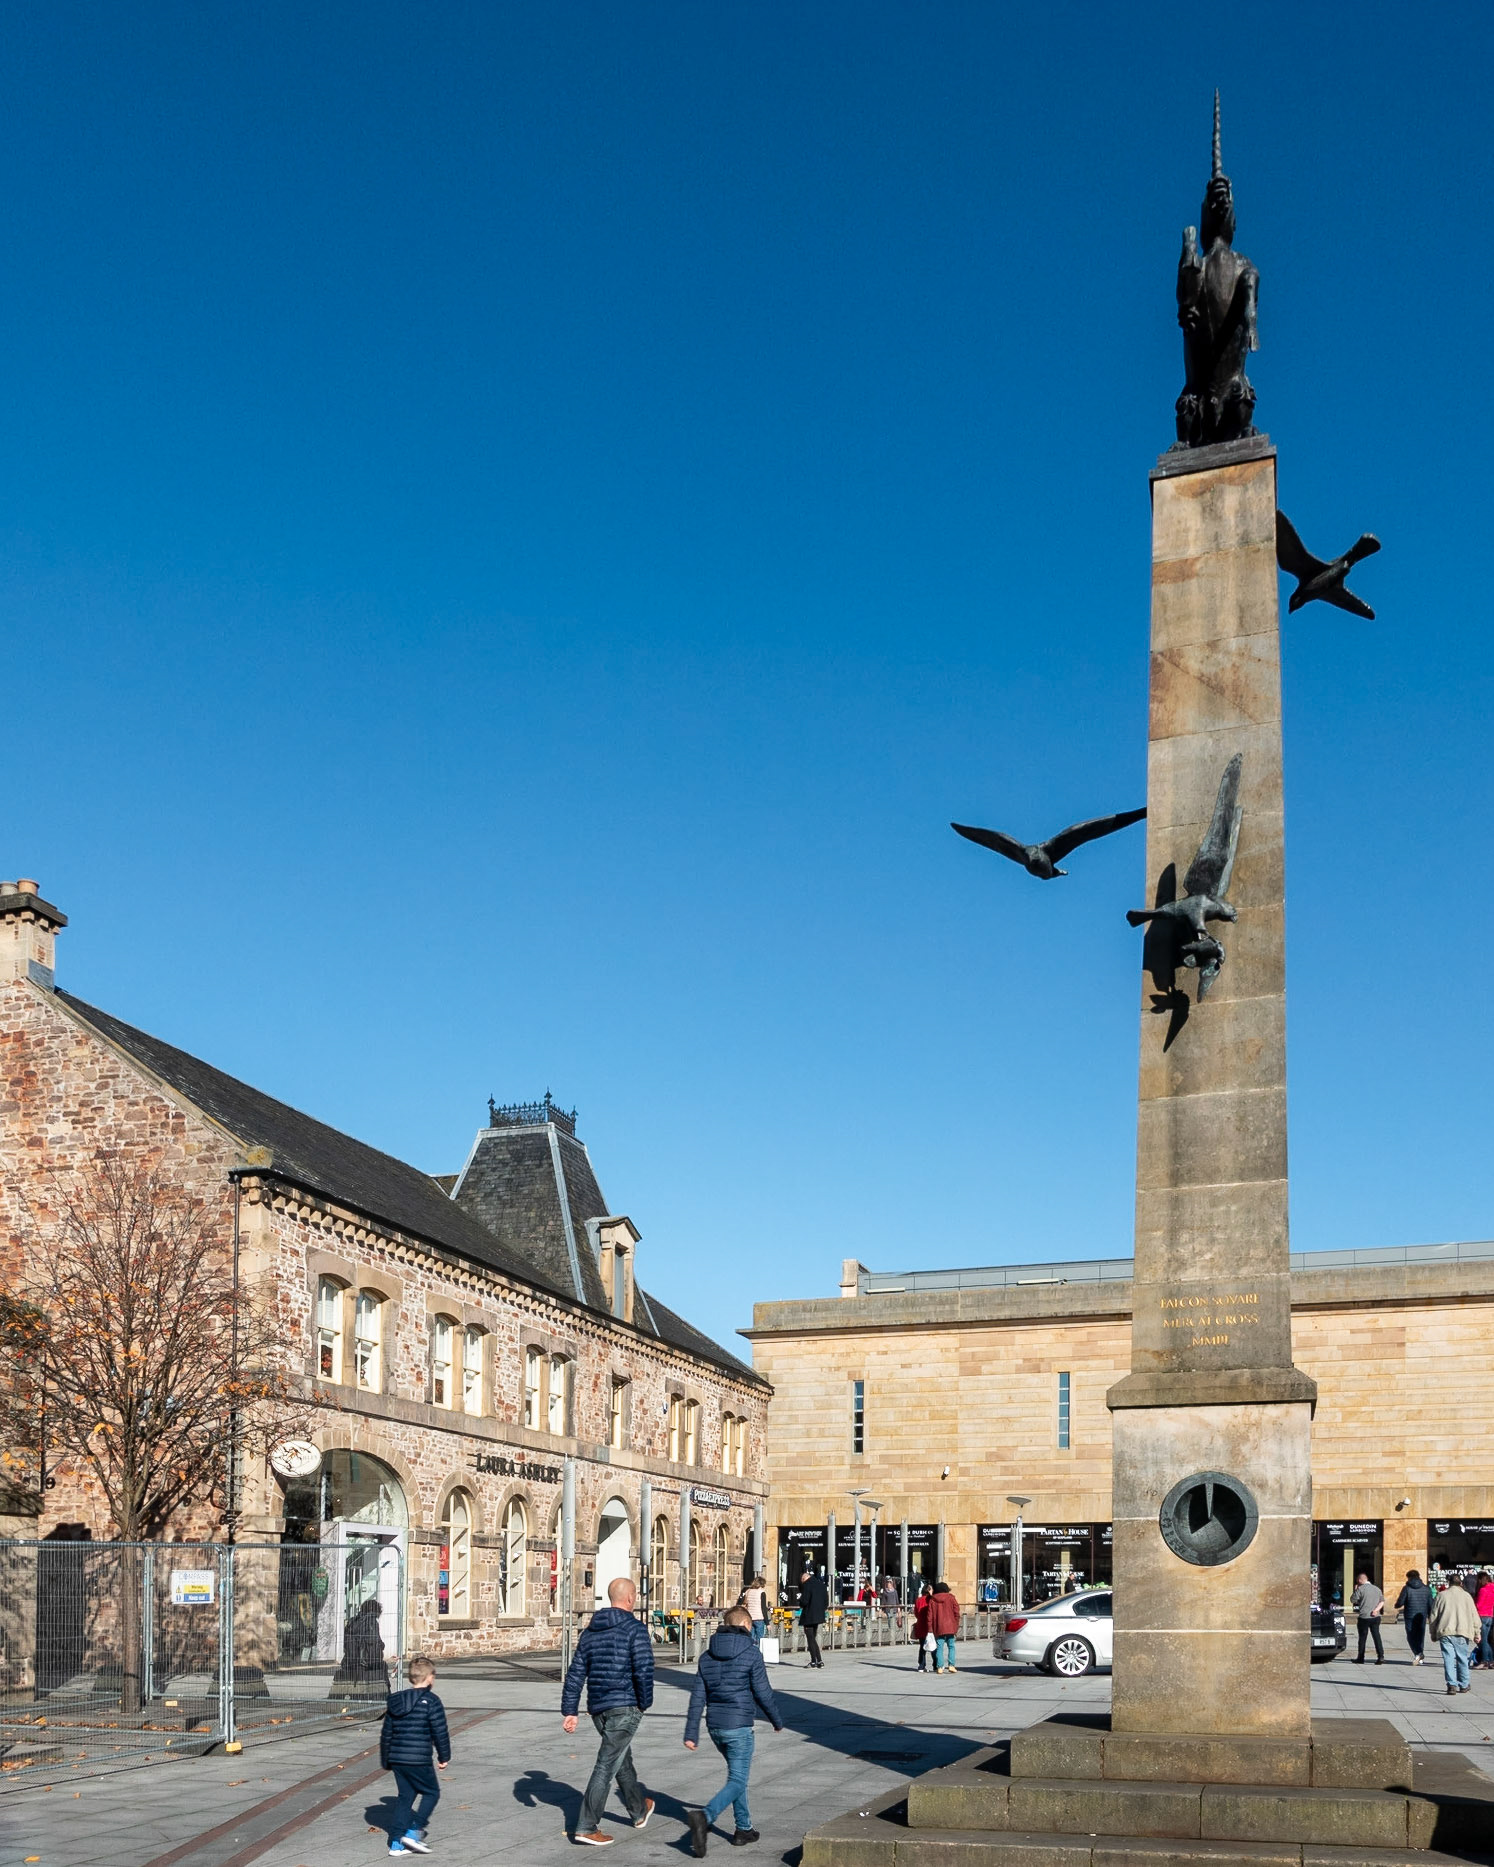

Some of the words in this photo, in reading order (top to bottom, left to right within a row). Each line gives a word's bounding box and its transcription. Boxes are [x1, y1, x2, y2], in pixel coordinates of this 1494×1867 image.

[1215, 1312, 1259, 1325] CROSS
[476, 1453, 515, 1477] LAURA
[519, 1462, 560, 1484] ASHLEY
[1040, 1528, 1064, 1536] TARTAN
[1068, 1528, 1089, 1536] HOUSE
